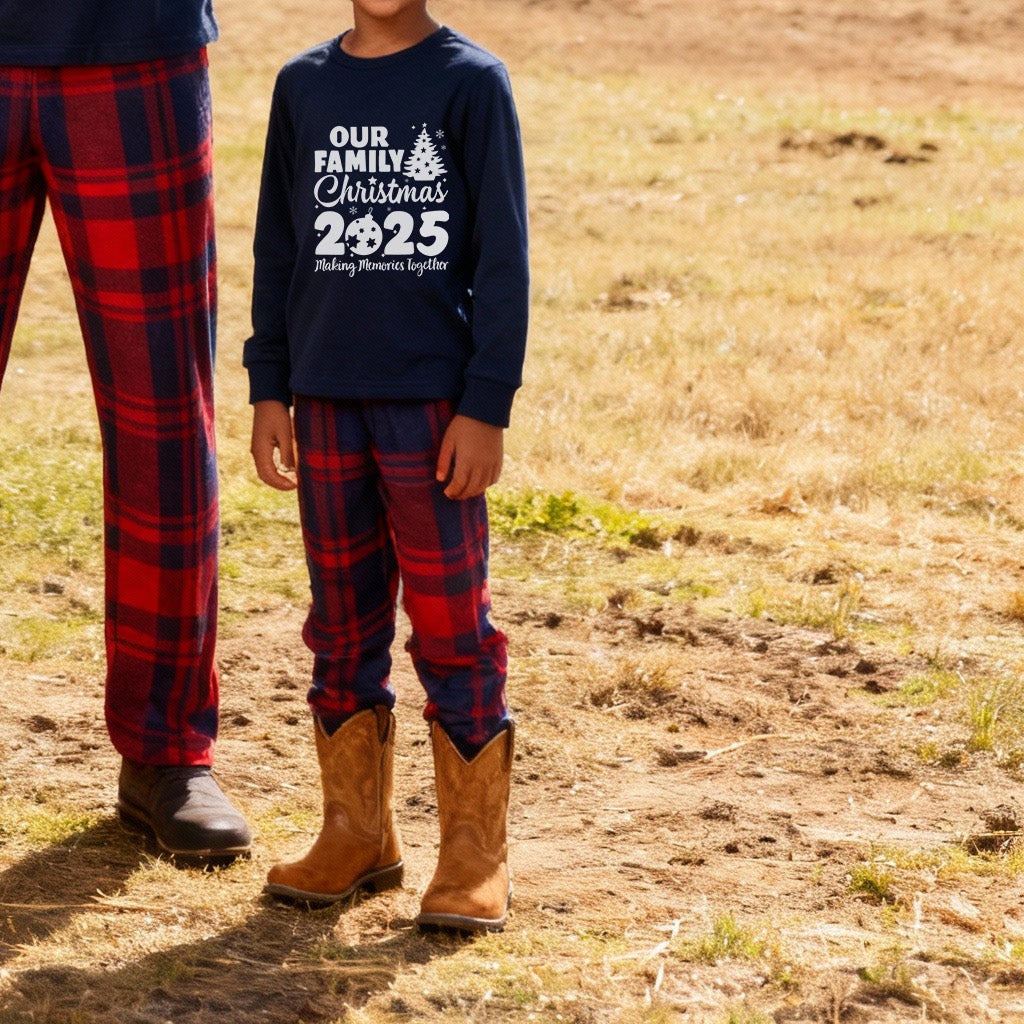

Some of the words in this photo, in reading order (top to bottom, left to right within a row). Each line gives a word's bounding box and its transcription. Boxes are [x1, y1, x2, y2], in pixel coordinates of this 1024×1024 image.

[329, 126, 389, 148] OUR
[314, 149, 404, 172] FAMILY
[314, 174, 449, 207] Christmas
[314, 210, 449, 256] 2025
[314, 258, 357, 277] Making
[358, 259, 404, 271] Memories
[407, 257, 449, 277] Together
